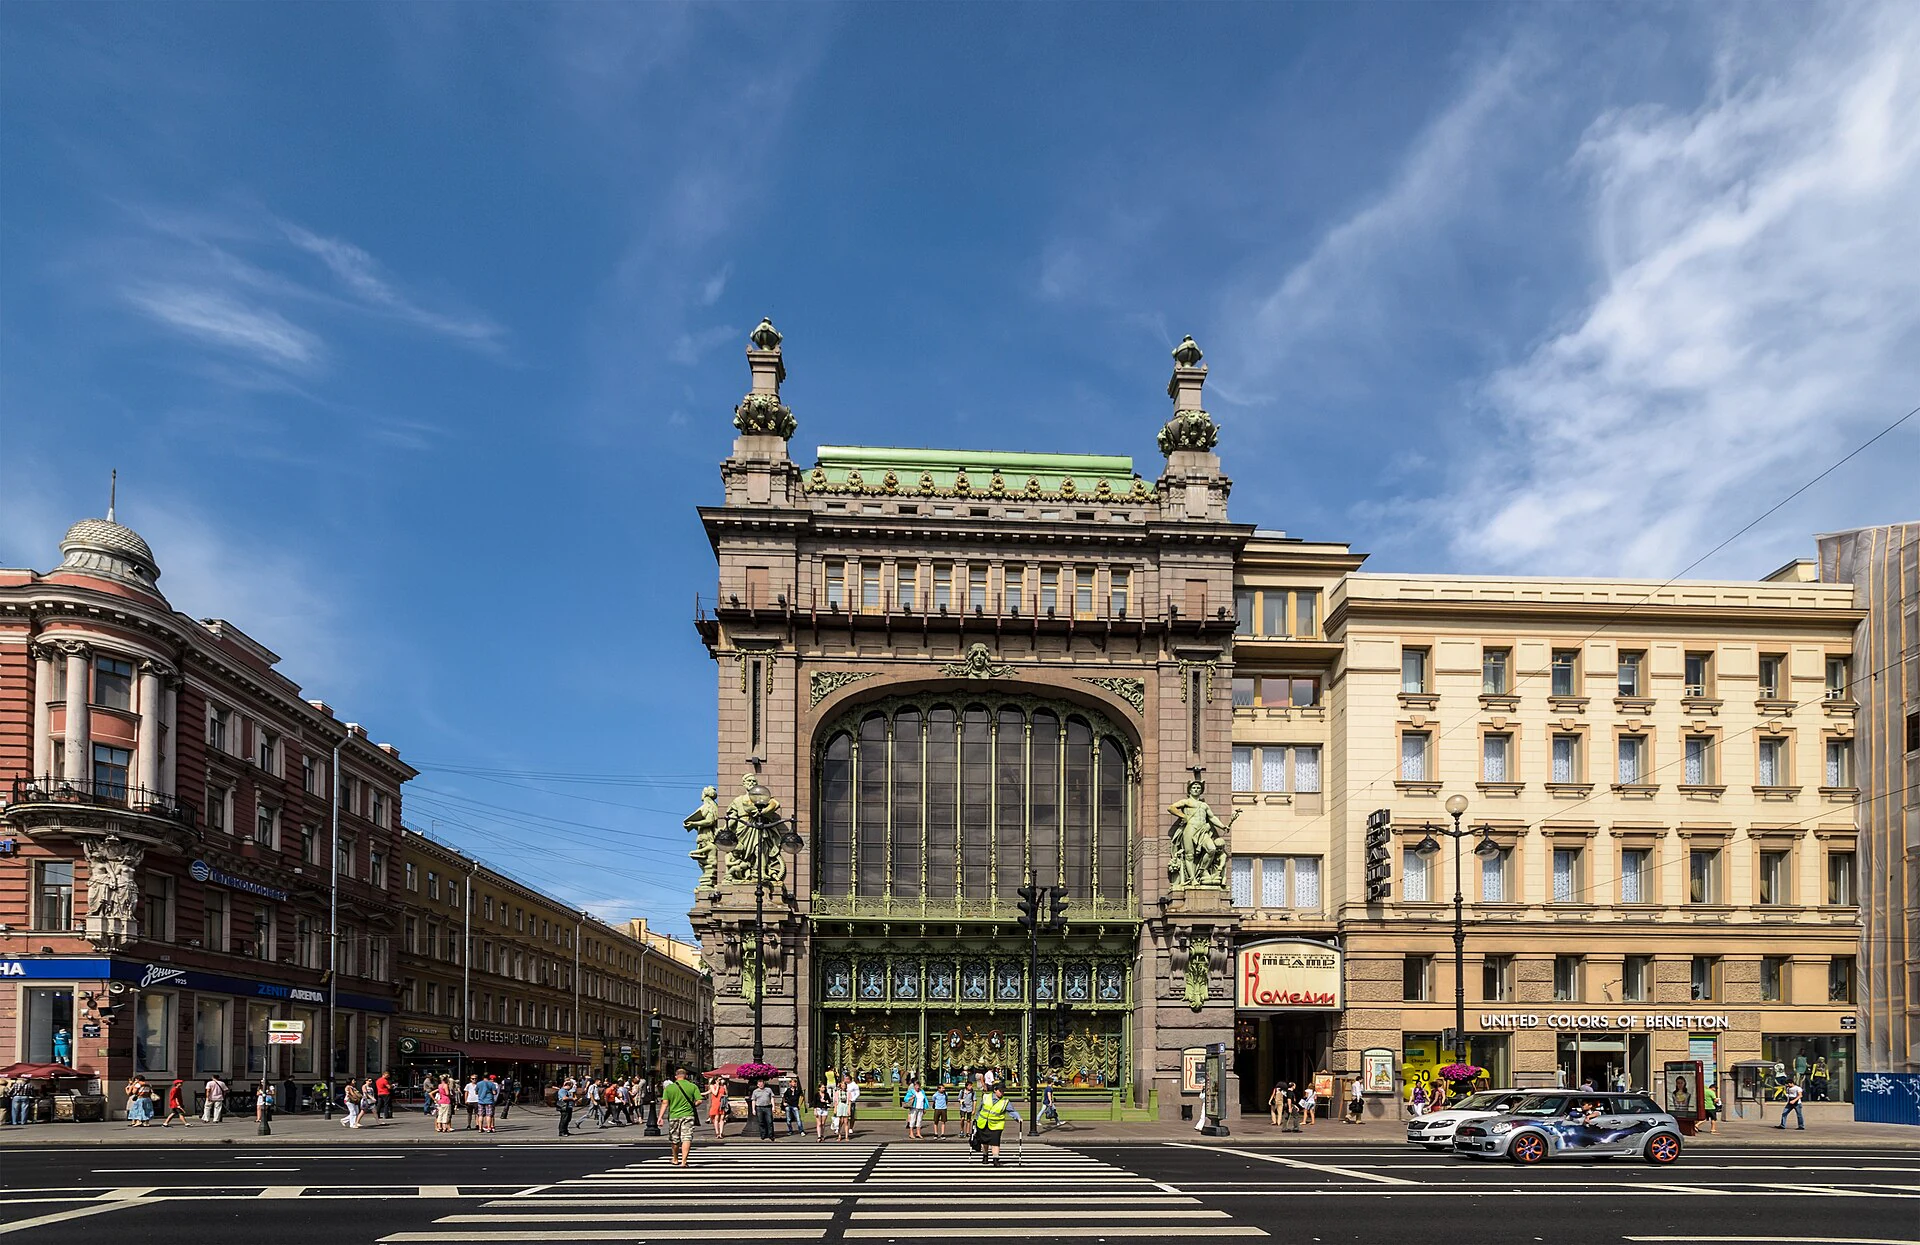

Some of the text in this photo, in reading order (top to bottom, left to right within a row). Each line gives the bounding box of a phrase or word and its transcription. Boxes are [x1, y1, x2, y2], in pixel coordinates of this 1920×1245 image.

[174, 977, 187, 985] 1925
[257, 984, 324, 1003] ZENIT ARENA
[1481, 1014, 1539, 1028] UNITED
[1547, 1014, 1609, 1028] COLORS
[1617, 1014, 1639, 1028] OF
[468, 1028, 551, 1046] COFFEESHOP COMPANY
